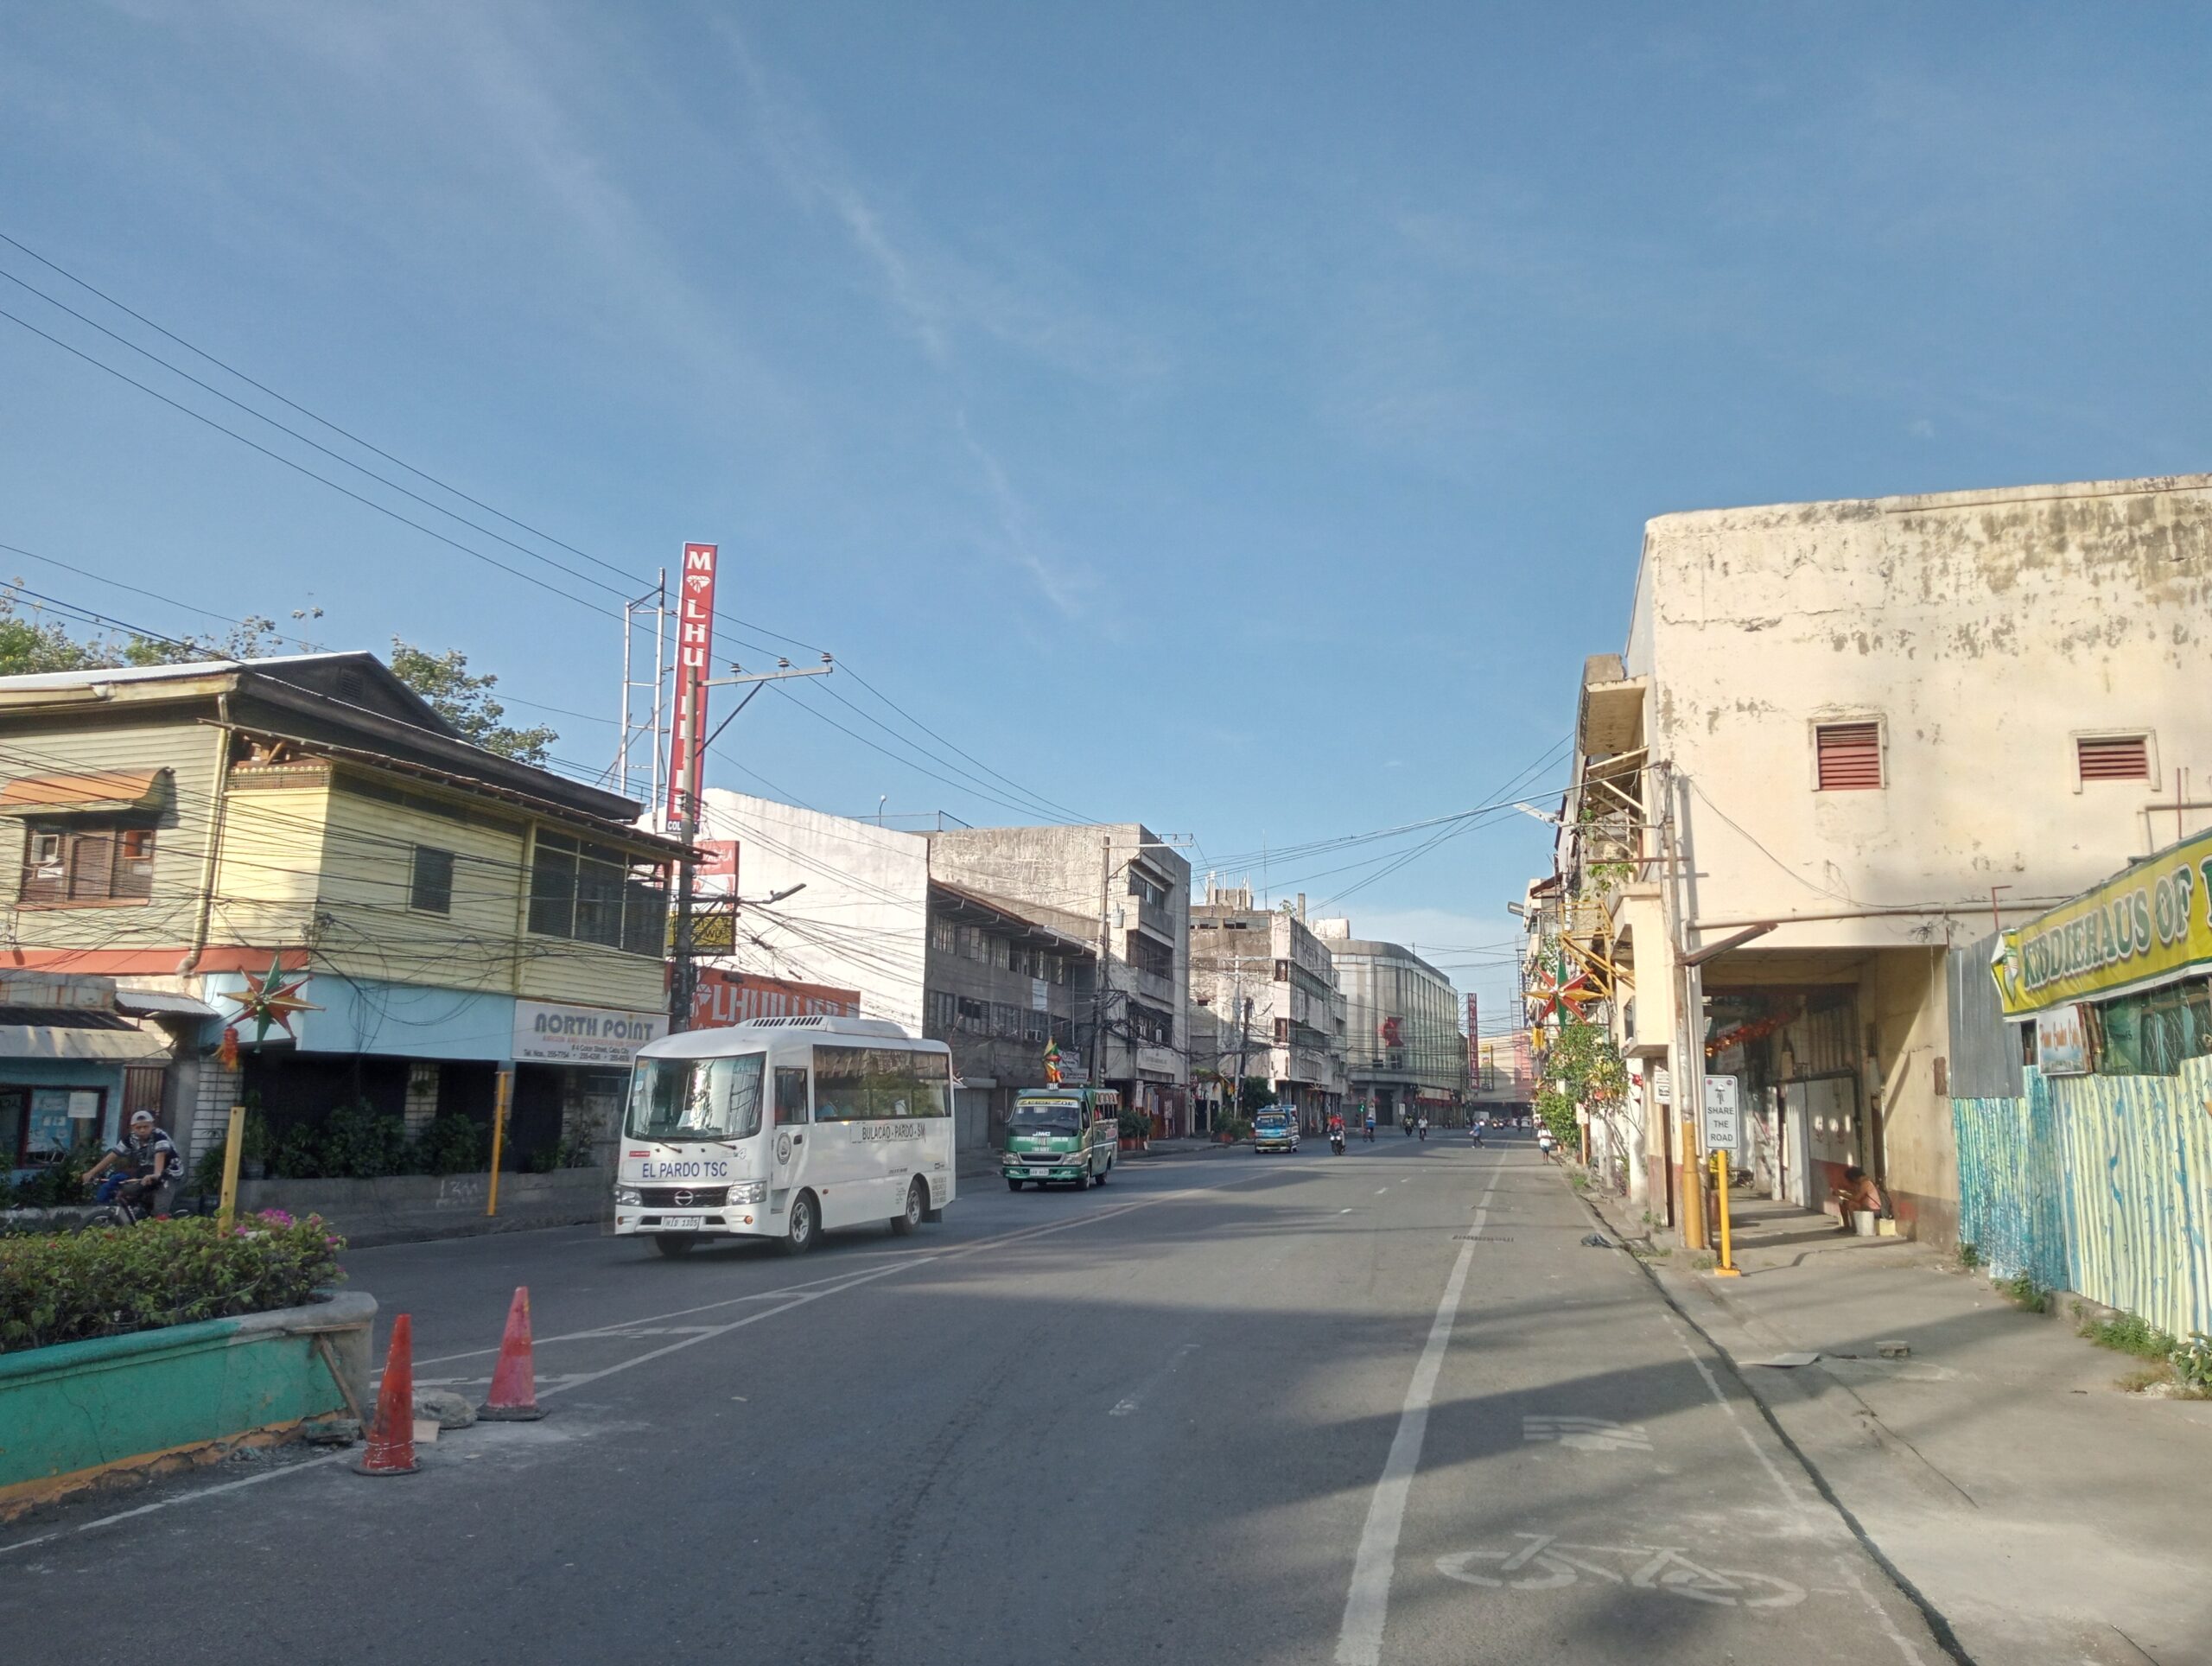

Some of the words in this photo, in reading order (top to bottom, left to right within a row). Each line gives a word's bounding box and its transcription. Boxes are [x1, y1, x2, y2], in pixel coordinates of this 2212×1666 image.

[688, 550, 712, 570] M
[2154, 862, 2194, 944] OF
[535, 1013, 598, 1036] NORTH
[602, 1018, 654, 1040] POINT
[1707, 1106, 1735, 1115] SHARE
[861, 1126, 891, 1140] BULACAO
[894, 1124, 913, 1138] PARDO
[1713, 1120, 1729, 1129] THE
[1710, 1133, 1733, 1141] ROAD
[642, 1163, 656, 1178] EL
[659, 1162, 700, 1177] PARDO
[704, 1161, 728, 1177] TSC
